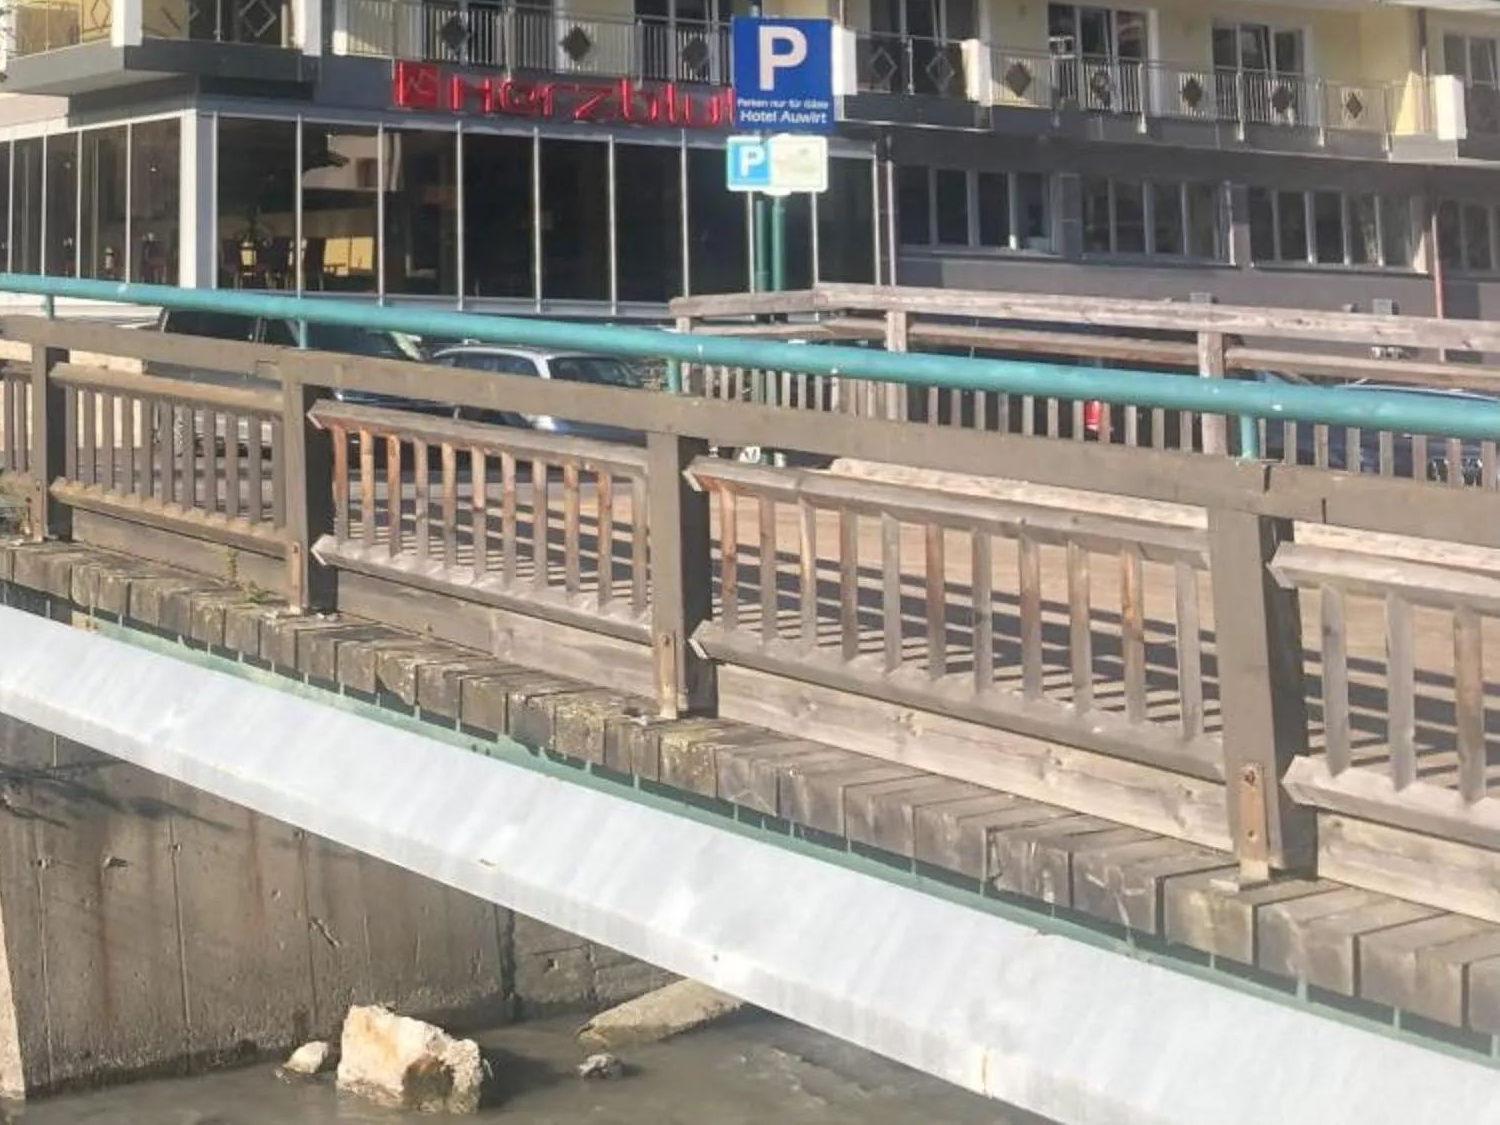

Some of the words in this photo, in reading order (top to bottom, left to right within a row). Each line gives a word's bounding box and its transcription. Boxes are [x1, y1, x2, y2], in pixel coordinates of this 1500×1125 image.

[759, 26, 807, 91] P
[740, 110, 777, 123] Hotel
[780, 110, 827, 124] Auwirt
[740, 146, 765, 177] P
